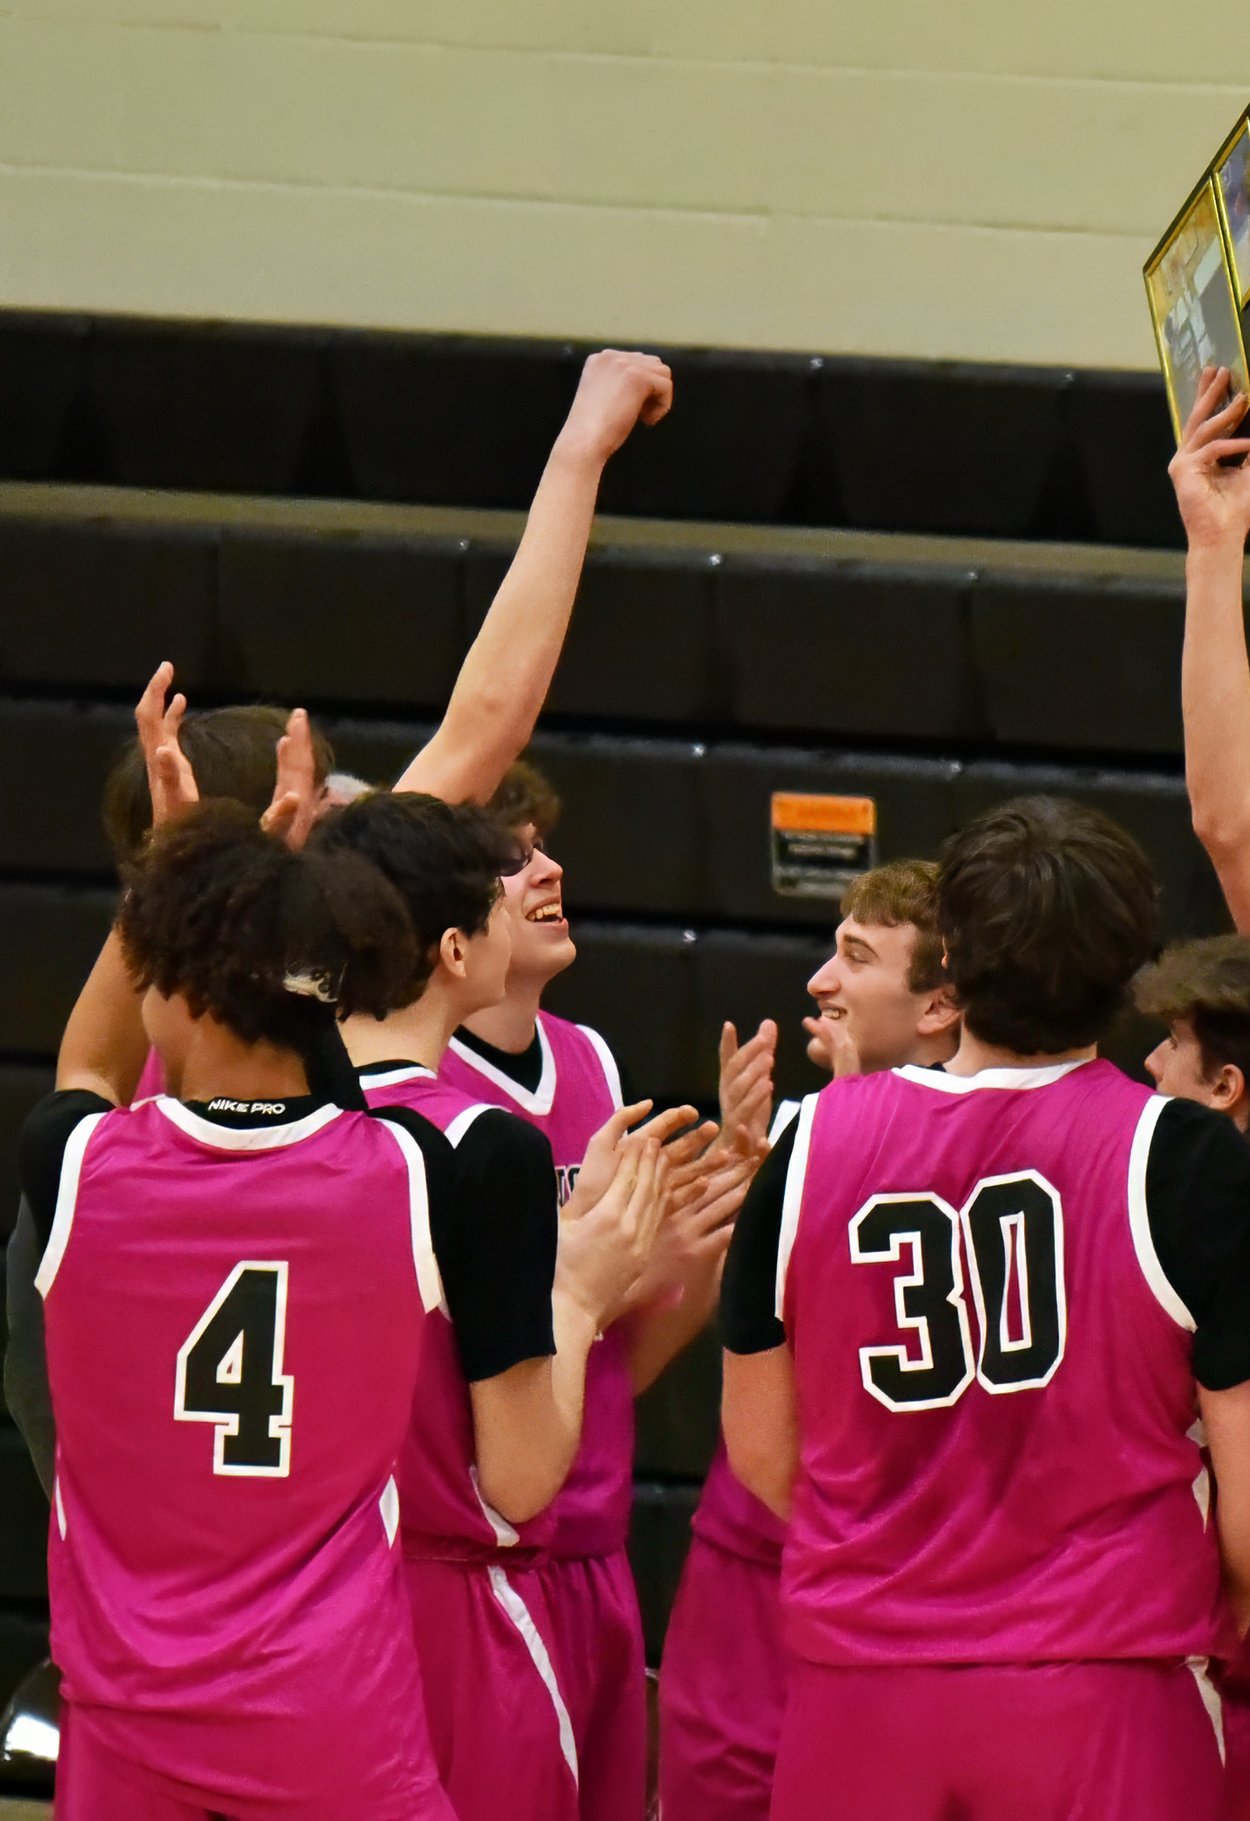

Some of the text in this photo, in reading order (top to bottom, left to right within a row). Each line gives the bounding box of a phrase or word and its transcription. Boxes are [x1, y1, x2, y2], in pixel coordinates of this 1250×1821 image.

[208, 1099, 286, 1115] NIKE PRO
[173, 1260, 294, 1477] 4
[848, 1168, 1067, 1412] 30
